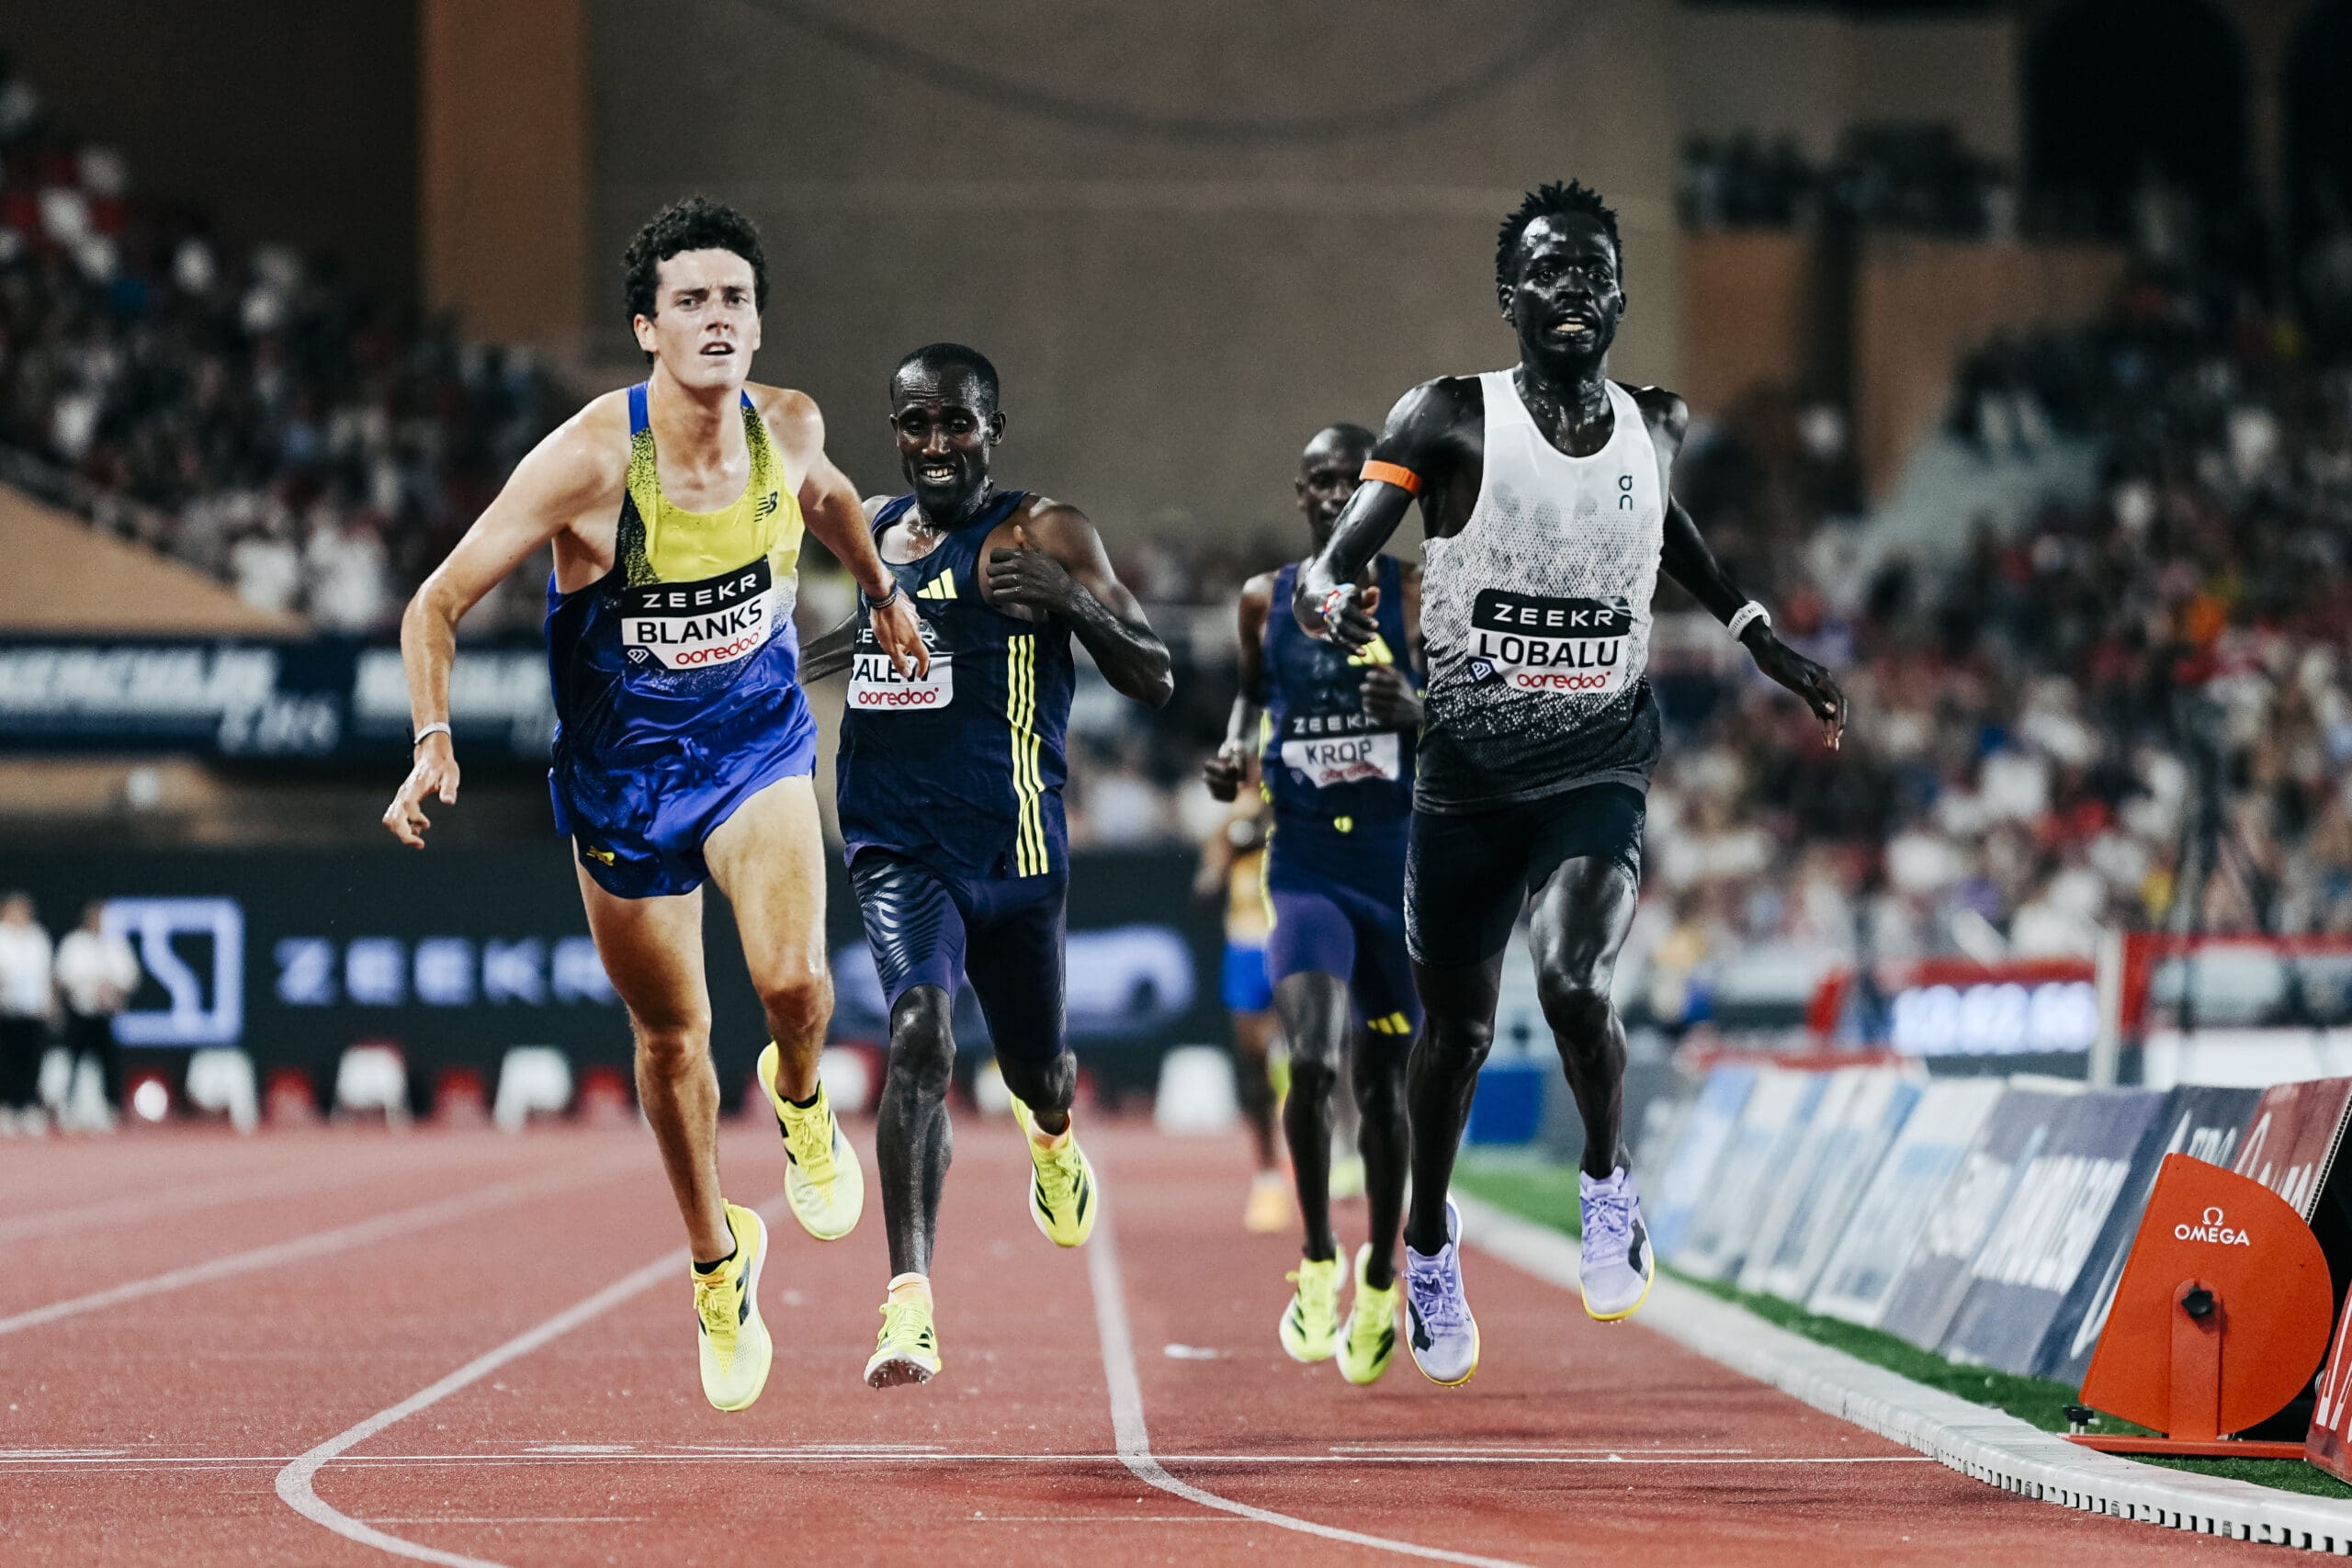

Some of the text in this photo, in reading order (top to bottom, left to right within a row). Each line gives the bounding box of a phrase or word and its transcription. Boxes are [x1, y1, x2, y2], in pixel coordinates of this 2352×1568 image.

[642, 573, 757, 608] ZEEKR
[637, 599, 763, 644] BLANKS
[1493, 603, 1614, 627] ZEEKR
[675, 627, 762, 665] ooredoo
[1479, 633, 1619, 668] LOBALU
[1517, 671, 1611, 690] ooredoo
[858, 687, 939, 705] ooredoo
[1306, 739, 1372, 764] KROP
[2174, 1224, 2250, 1247] OMEGA
